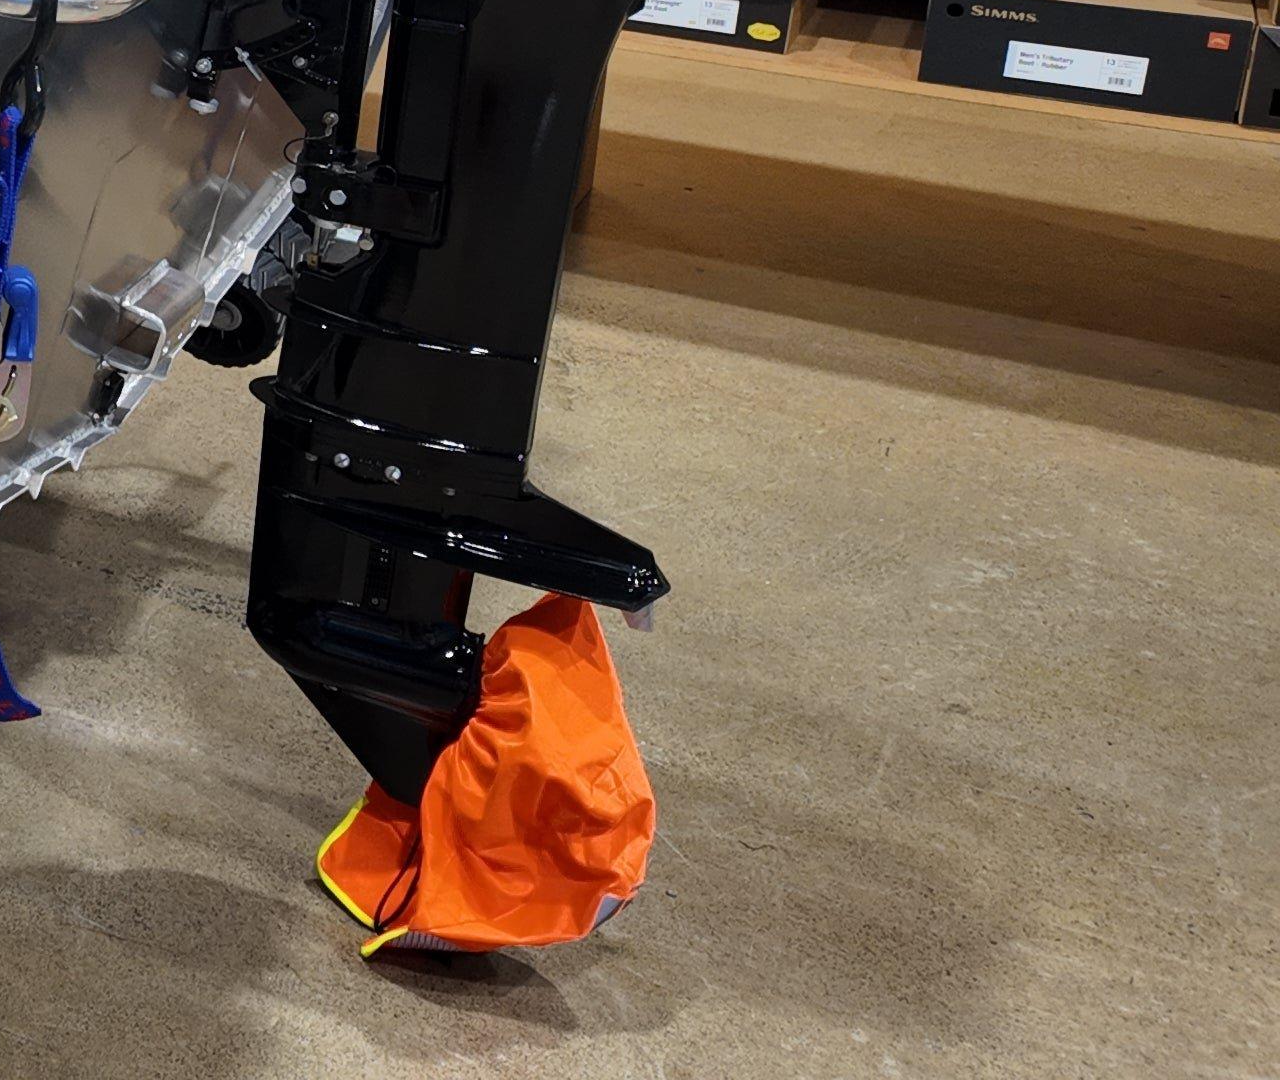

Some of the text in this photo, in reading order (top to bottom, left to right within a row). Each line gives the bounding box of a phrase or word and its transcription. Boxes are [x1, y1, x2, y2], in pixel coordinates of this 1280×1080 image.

[971, 4, 1037, 23] SIMMS
[1041, 62, 1068, 70] Rubber
[1042, 54, 1074, 65] Tributary
[1106, 58, 1116, 66] 13
